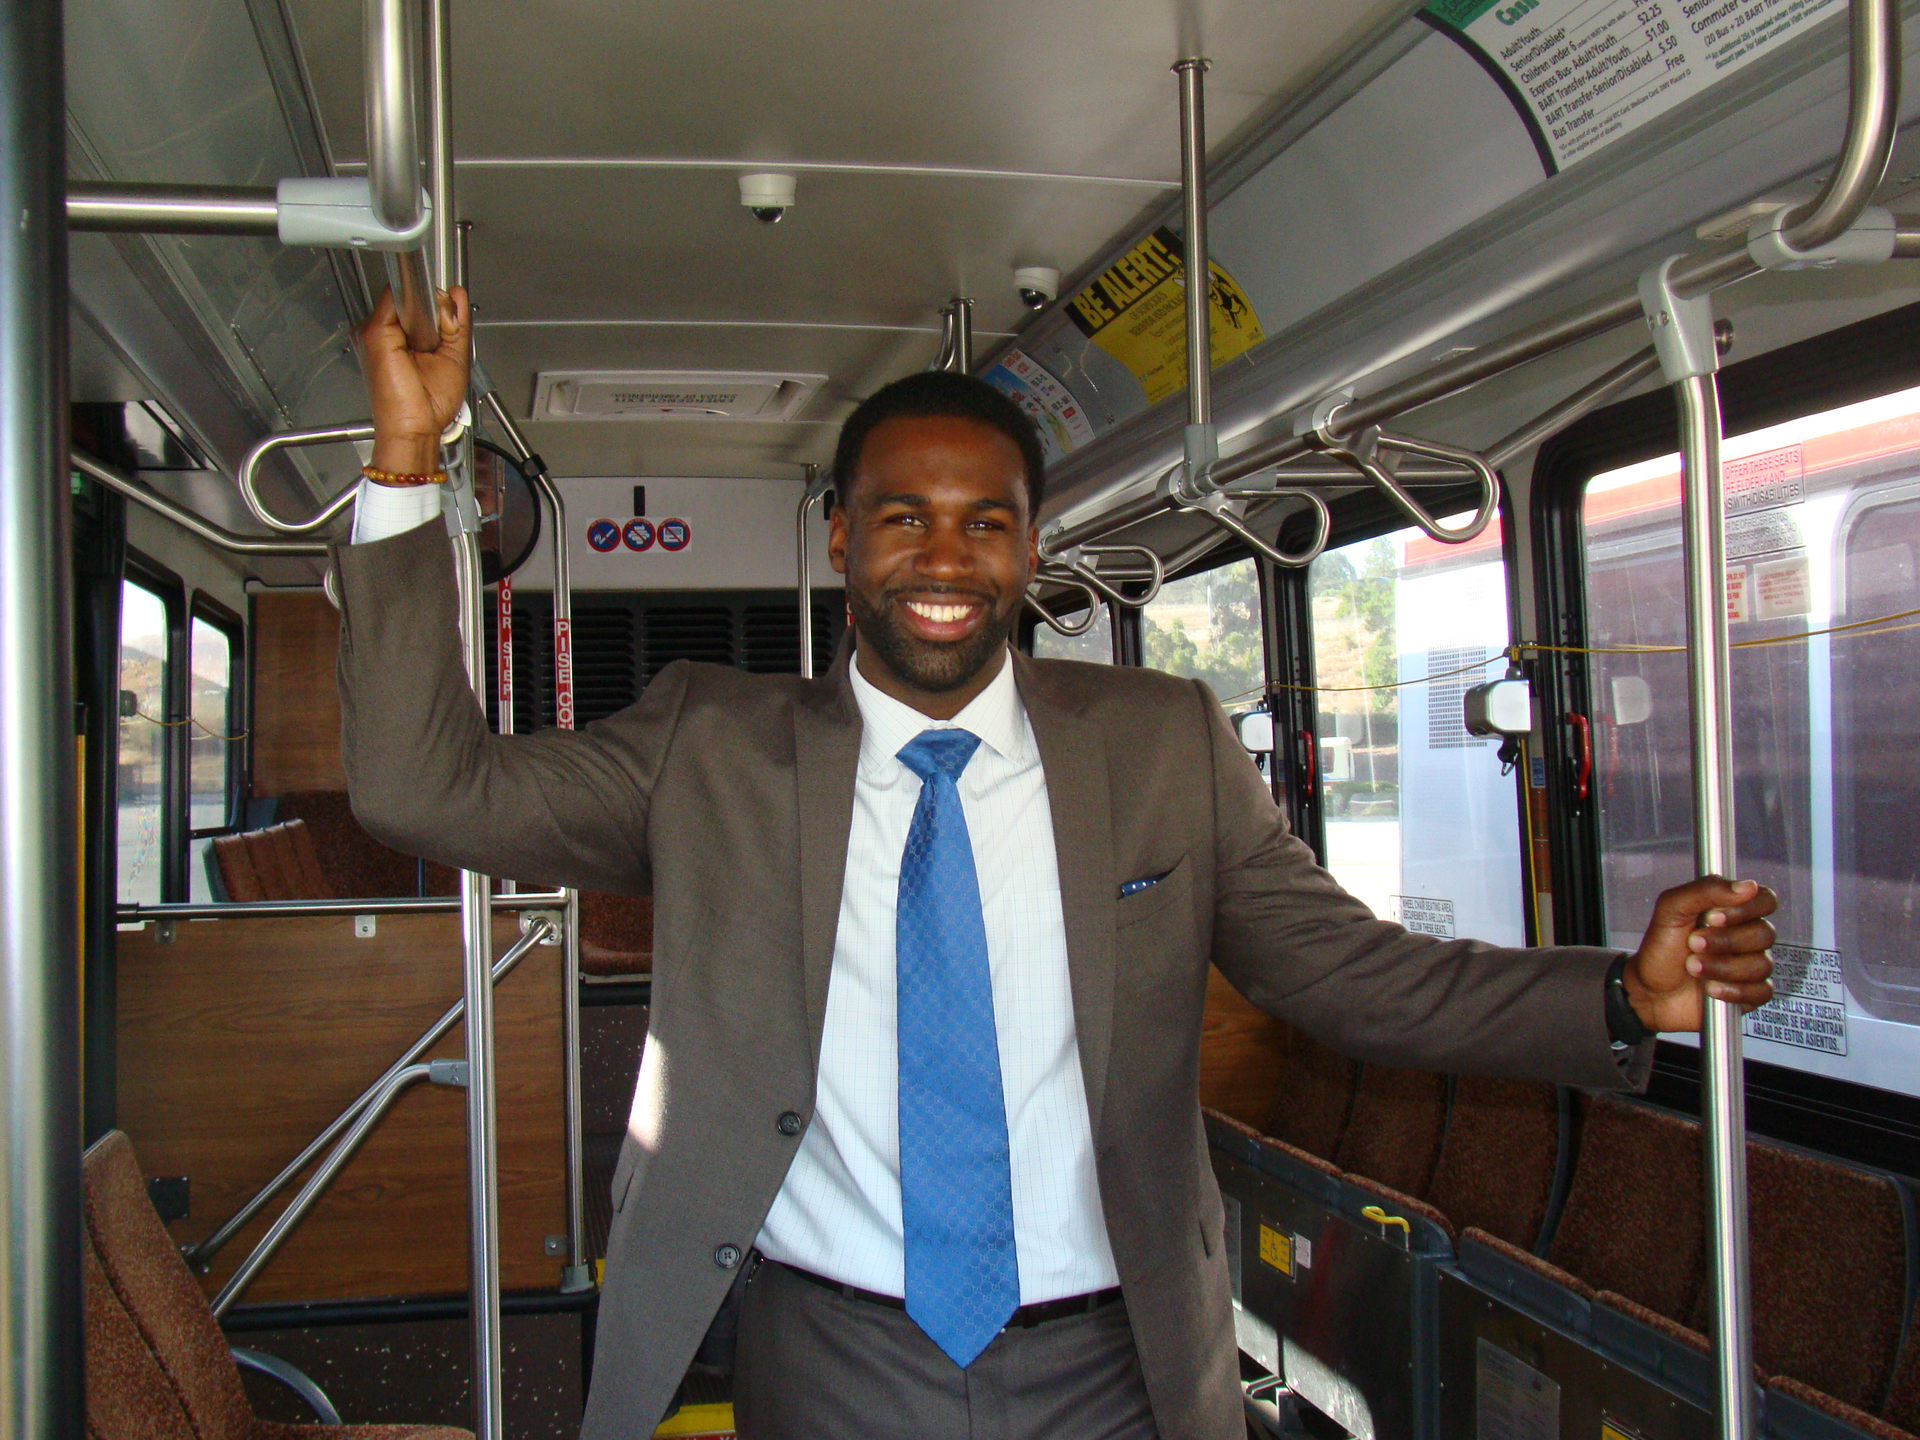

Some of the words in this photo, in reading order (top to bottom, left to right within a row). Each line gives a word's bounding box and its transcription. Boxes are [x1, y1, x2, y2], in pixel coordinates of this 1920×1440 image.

[1691, 0, 1738, 34] Commuter
[1704, 33, 1716, 47] (20
[1715, 26, 1729, 39] Bus
[1734, 15, 1745, 27] 20
[1744, 2, 1764, 21] BART
[1766, 20, 1792, 39] Locations
[1500, 27, 1542, 60] Adult/Youth
[1529, 76, 1558, 97] Express
[1555, 67, 1573, 81] Bus-
[1572, 34, 1618, 70] Adult/Youth
[1637, 4, 1662, 25] $2.25
[1521, 60, 1551, 84] Children
[1550, 47, 1571, 70] under
[1569, 41, 1578, 51] 6
[1538, 92, 1557, 111] BART
[1556, 45, 1632, 100] Transfer-Adult/Youth
[1645, 20, 1669, 41] $1.00
[1545, 107, 1565, 125] BART
[1563, 50, 1653, 114] Transfer-Senior/Disabled
[1658, 35, 1678, 55] $.50
[1552, 126, 1567, 140] Bus
[1565, 109, 1595, 132] Transfer
[1665, 53, 1686, 71] Free
[1072, 286, 1115, 329] BE
[1097, 234, 1183, 310] ALERT!
[1725, 463, 1748, 479] OFFER
[1749, 456, 1773, 473] THESE
[1774, 450, 1799, 467] SEATS
[1734, 493, 1751, 509] WITH
[1753, 483, 1799, 504] DISABILITIES
[1736, 475, 1767, 493] ELDERLY
[1768, 470, 1786, 484] AND
[502, 576, 511, 629] YOUR
[557, 621, 570, 684] PISE
[503, 641, 512, 696] STEP
[1425, 901, 1441, 911] SEATING
[1435, 913, 1453, 924] LOCATED
[1410, 921, 1422, 931] BELOW
[1422, 922, 1434, 933] THESE
[1771, 947, 1788, 961] HAIR
[1789, 949, 1819, 965] SEATING
[1774, 961, 1793, 975] ENTS
[1808, 966, 1842, 984] LOCATED
[1781, 977, 1803, 994] THESE
[1804, 982, 1830, 998] SEATS.
[1760, 1008, 1789, 1026] SEGUROS
[1790, 1014, 1798, 1028] SE
[1800, 1016, 1843, 1037] ENCUENTRAN
[1781, 999, 1803, 1014] SILLAS
[1804, 1002, 1813, 1016] DE
[1814, 1004, 1844, 1021] RUEDAS.
[1753, 1021, 1773, 1038] ABAJO
[1773, 1025, 1783, 1040] DE
[1783, 1027, 1804, 1044] ESTOS
[1805, 1031, 1840, 1052] ASIENTOS.
